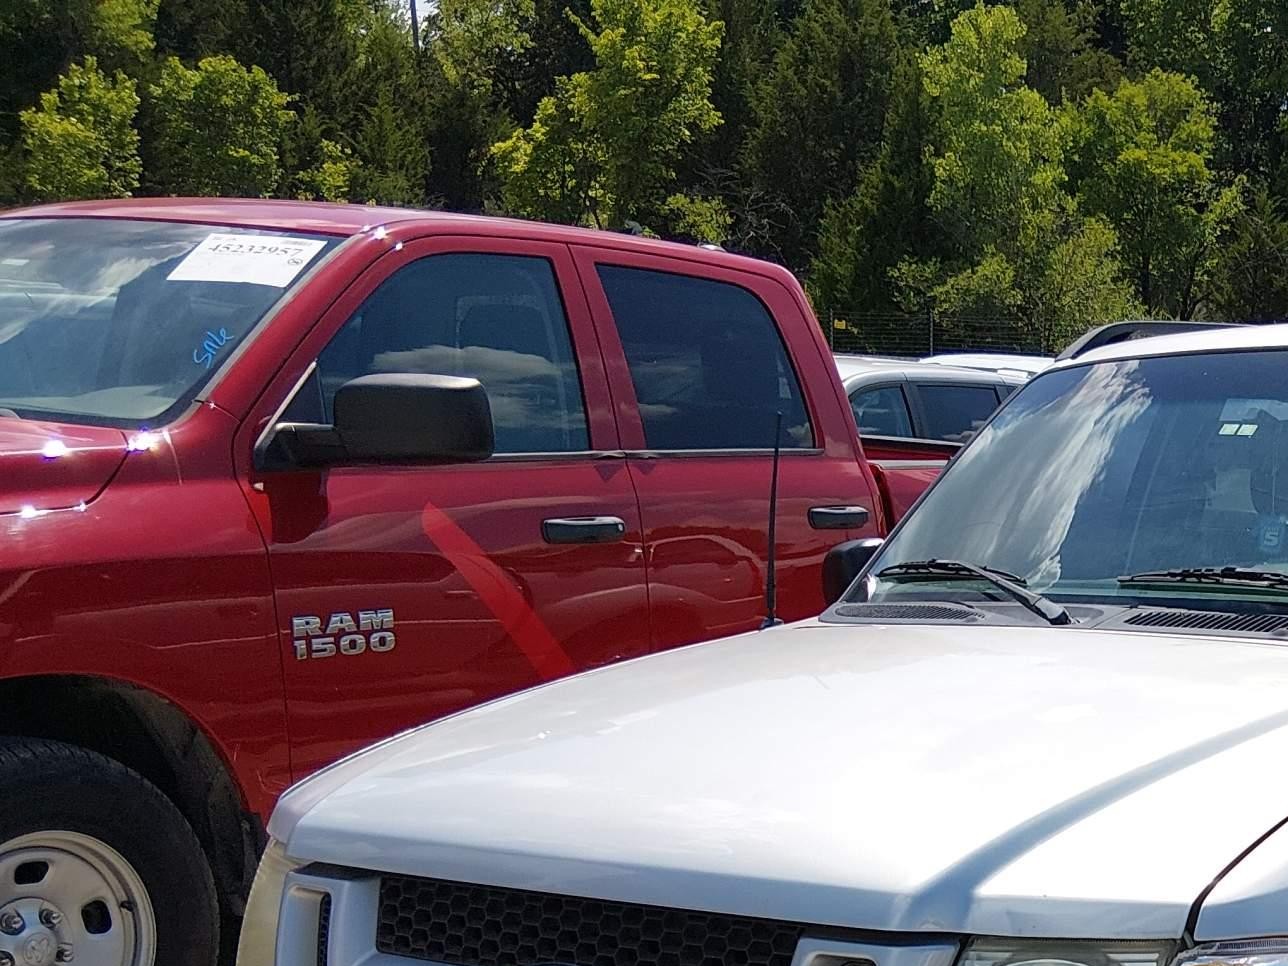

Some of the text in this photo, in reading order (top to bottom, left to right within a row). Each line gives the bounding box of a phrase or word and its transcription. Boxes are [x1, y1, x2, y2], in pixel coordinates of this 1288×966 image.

[208, 242, 303, 257] 45232957
[291, 608, 395, 638] RAM
[293, 631, 396, 661] 1500
